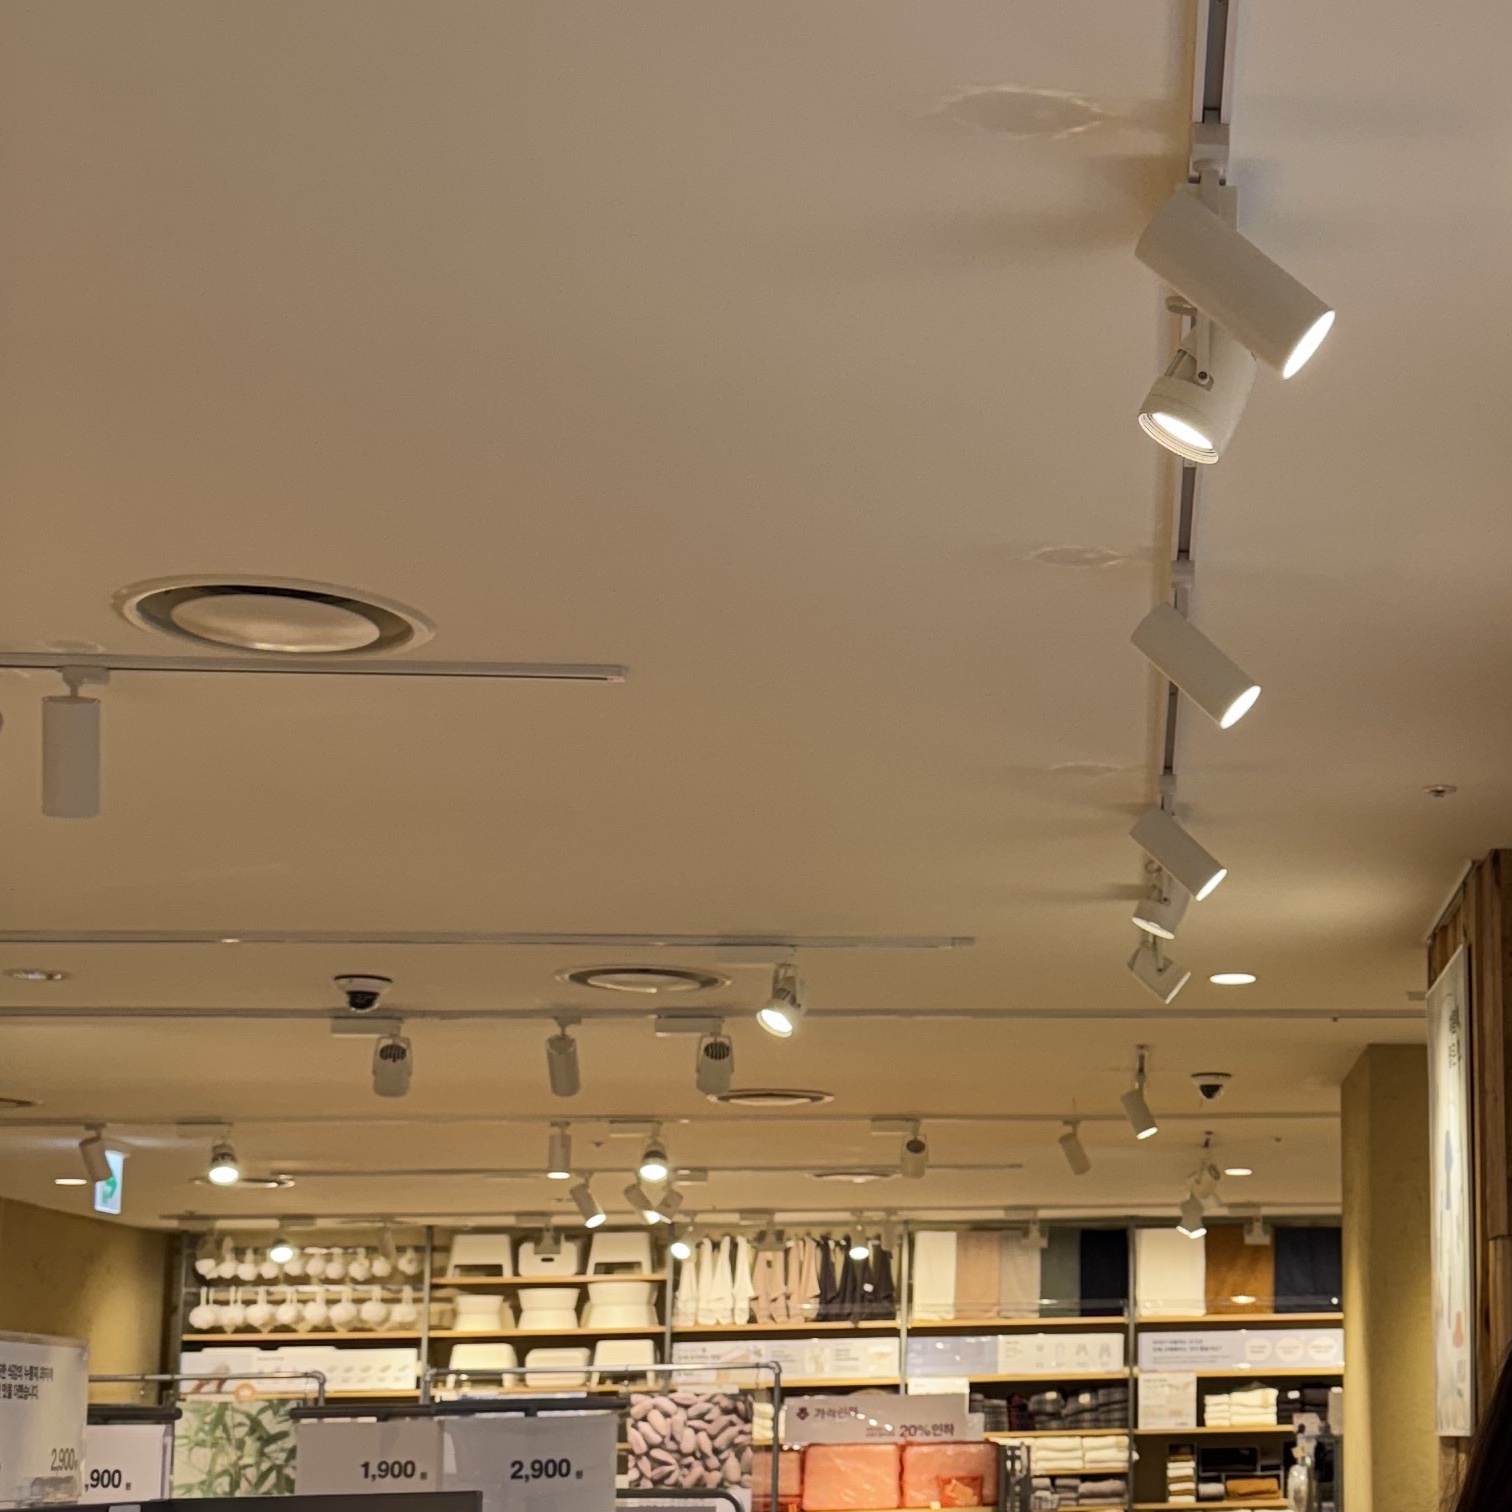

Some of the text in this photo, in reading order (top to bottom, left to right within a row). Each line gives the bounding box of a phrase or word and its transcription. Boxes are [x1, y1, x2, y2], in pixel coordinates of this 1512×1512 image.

[85, 1469, 121, 1492] ,900
[360, 1460, 416, 1481] 1,900
[510, 1458, 571, 1482] 2,900
